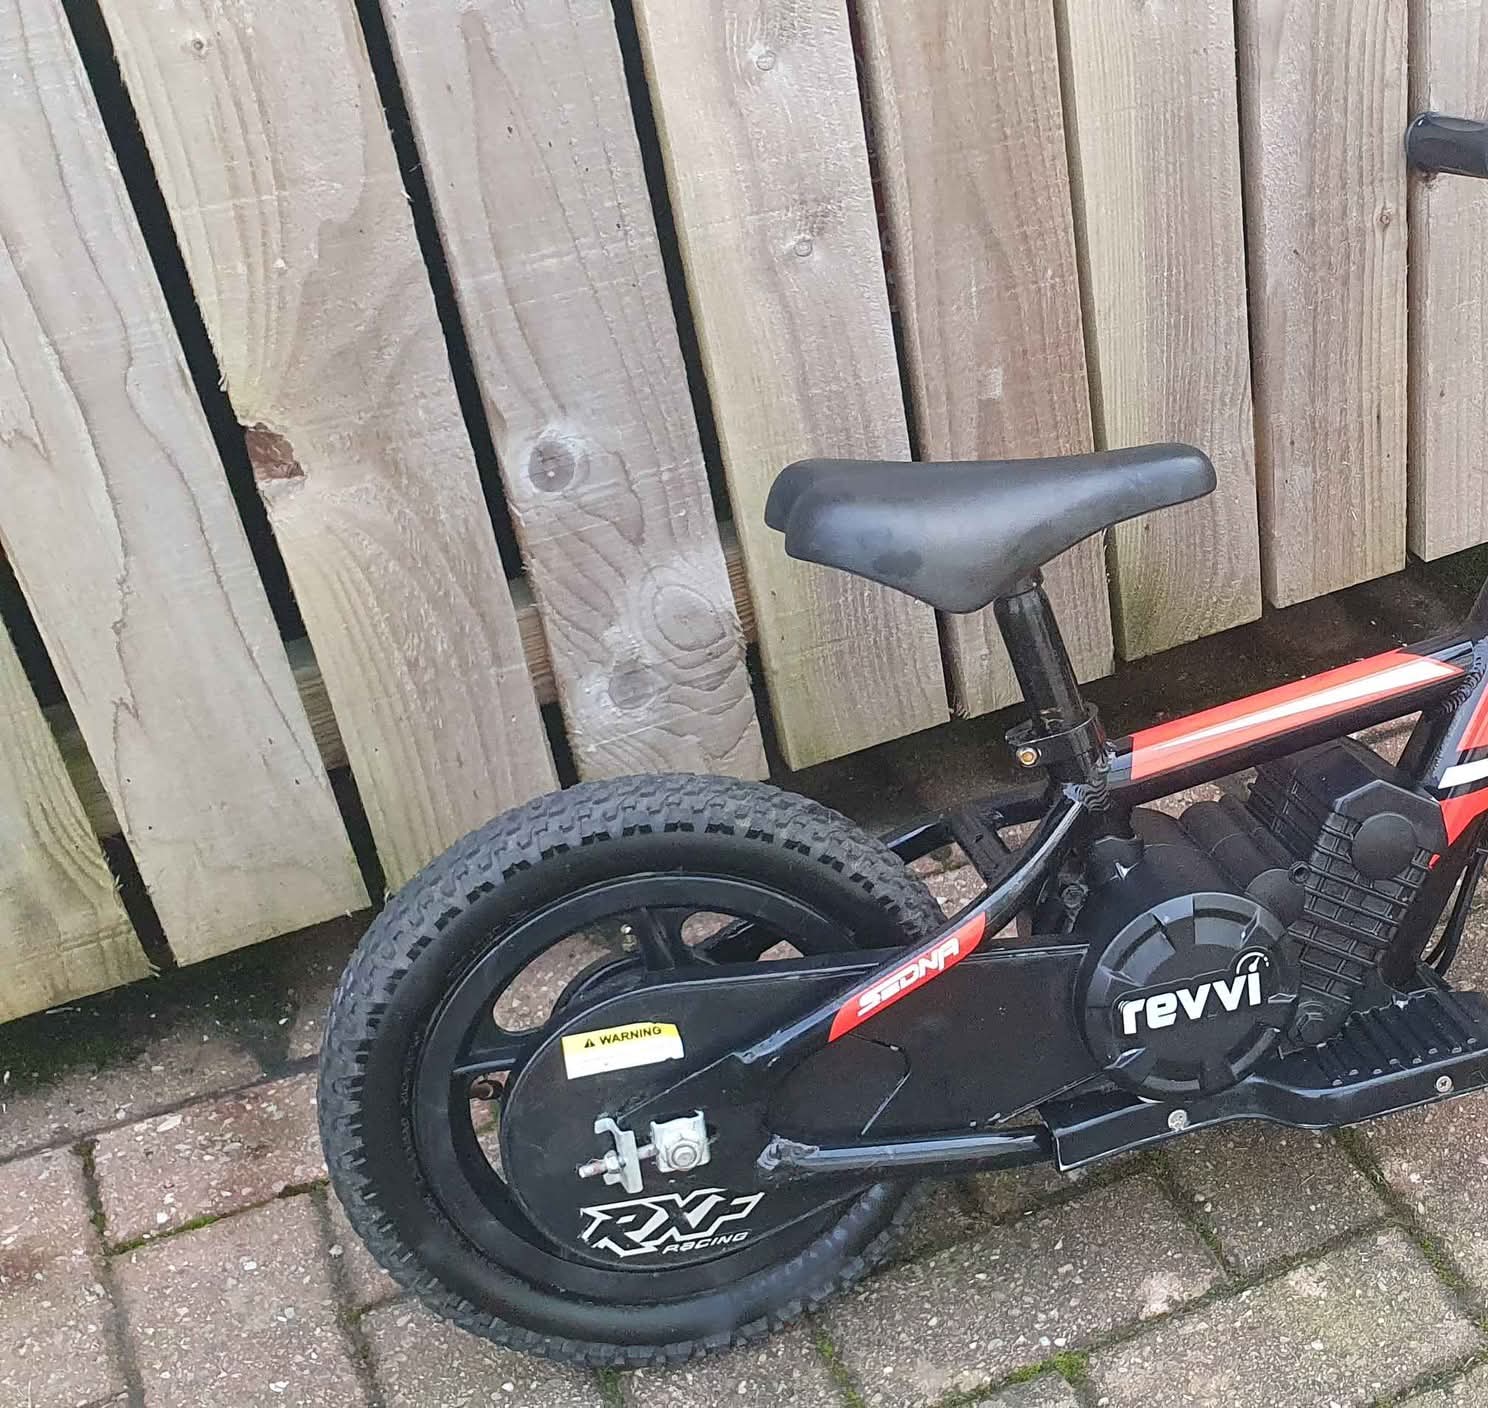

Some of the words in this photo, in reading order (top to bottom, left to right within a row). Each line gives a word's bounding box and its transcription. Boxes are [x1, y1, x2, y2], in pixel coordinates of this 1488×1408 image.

[857, 938, 960, 1017] SEDNA
[1118, 953, 1264, 1035] revvi
[600, 1026, 662, 1045] WARNING
[578, 1188, 765, 1257] RXF
